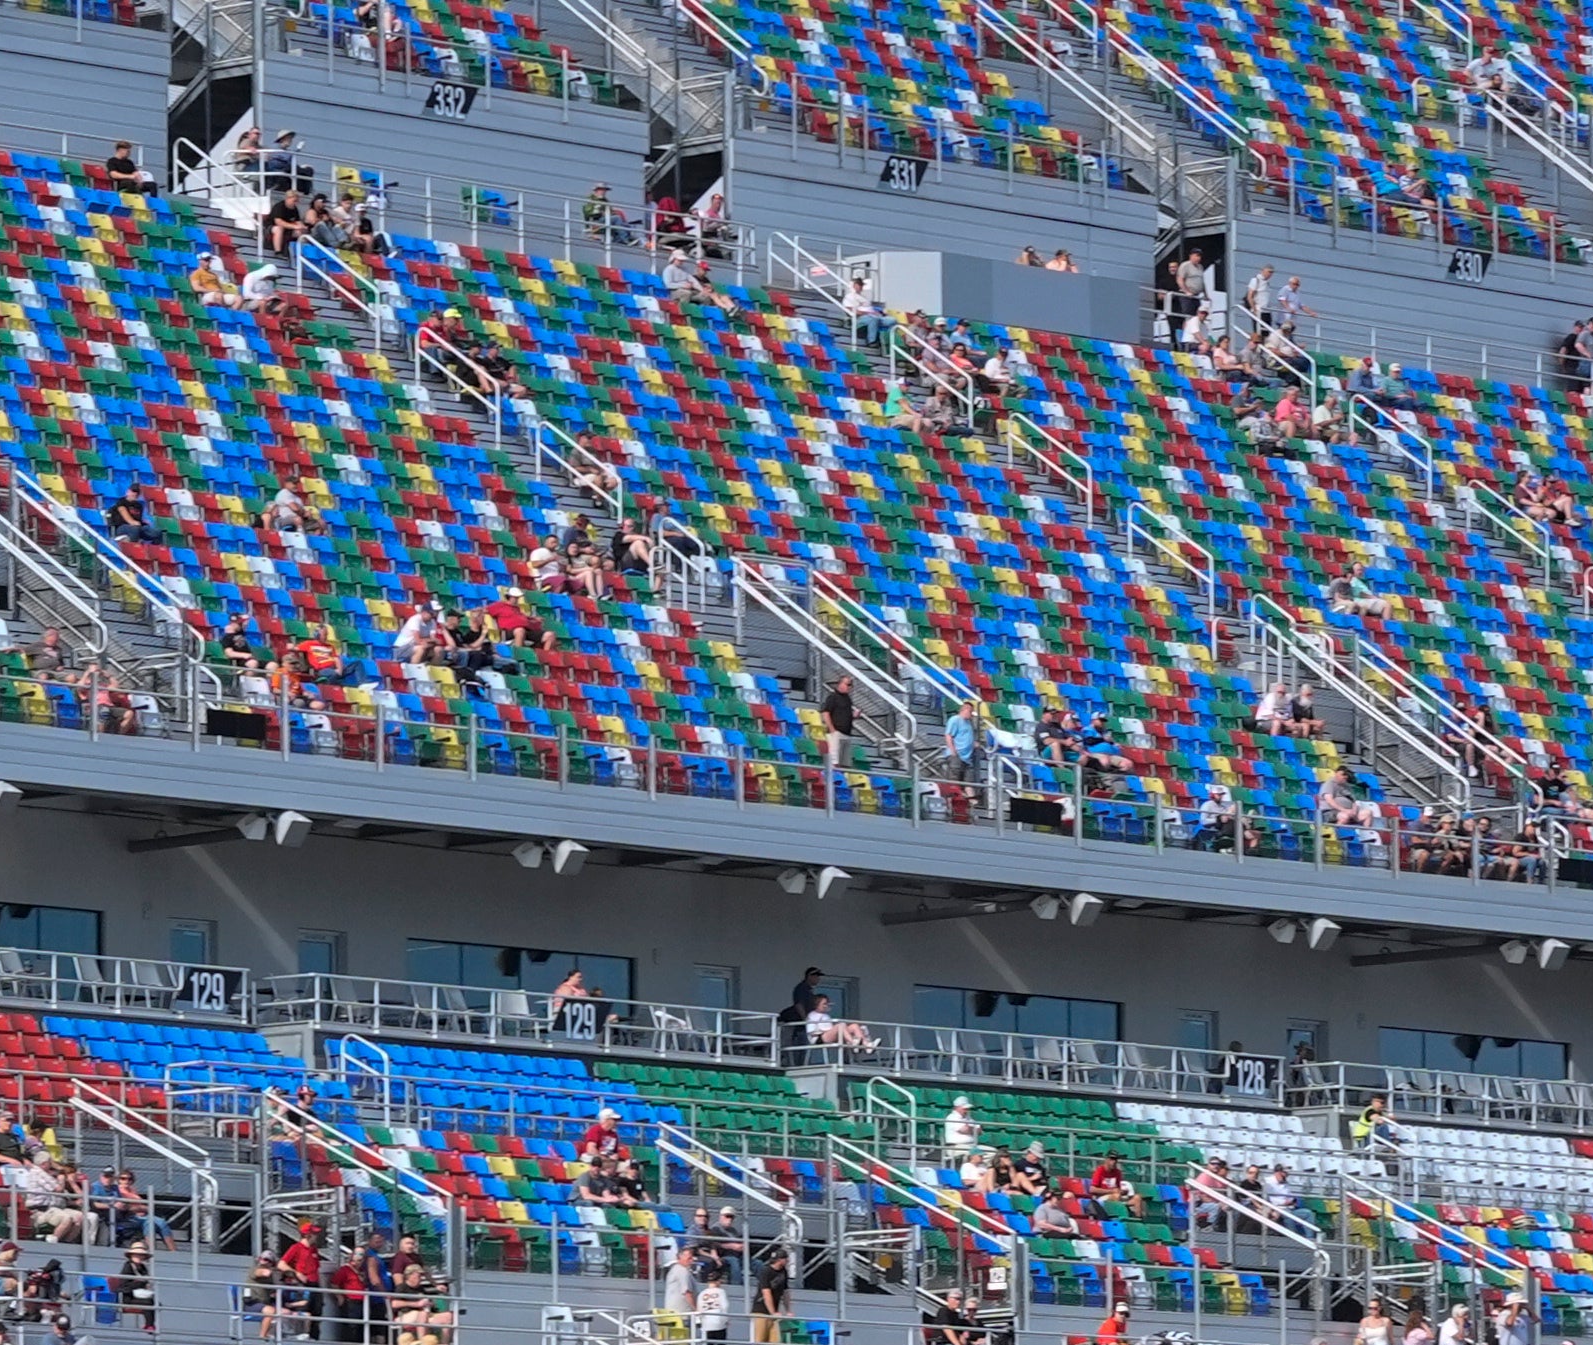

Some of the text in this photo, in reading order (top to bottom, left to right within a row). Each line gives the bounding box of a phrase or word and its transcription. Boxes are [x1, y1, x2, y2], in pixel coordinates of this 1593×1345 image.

[434, 81, 466, 119] 332
[890, 158, 918, 192] 331
[1456, 250, 1482, 283] 330
[191, 973, 224, 1011] 129
[565, 1002, 595, 1040] 129
[1236, 1059, 1265, 1096] 128
